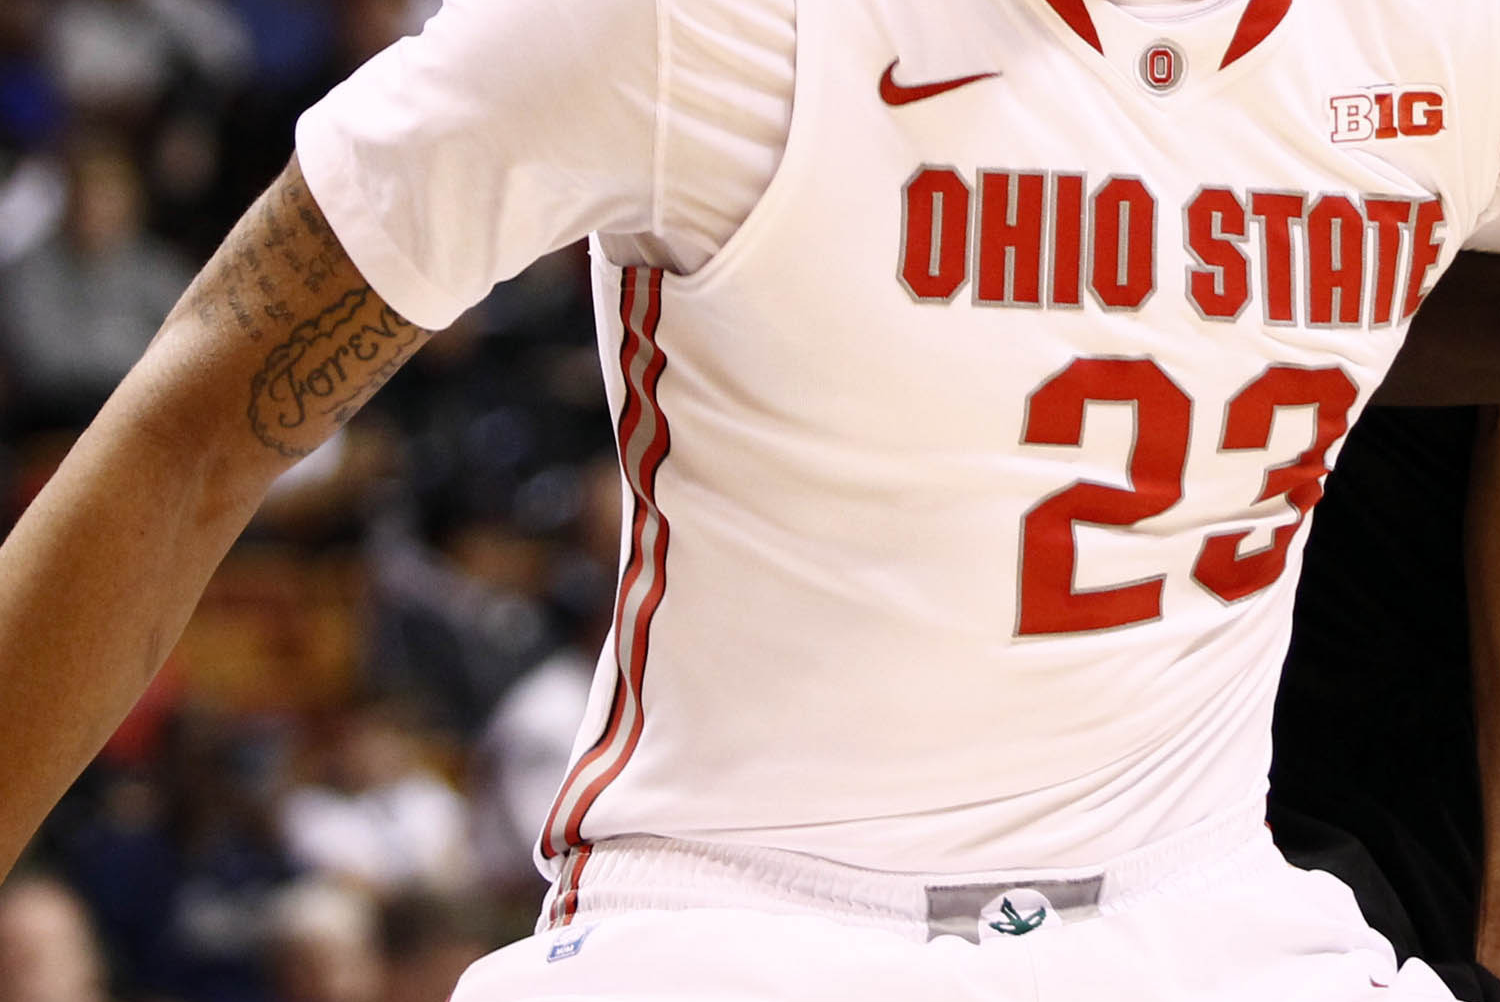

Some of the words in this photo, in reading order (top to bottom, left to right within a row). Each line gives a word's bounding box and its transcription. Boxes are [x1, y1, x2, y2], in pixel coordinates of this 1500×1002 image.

[896, 162, 1159, 312] OHIO
[1182, 183, 1449, 329] STATE
[1012, 353, 1361, 640] 23
